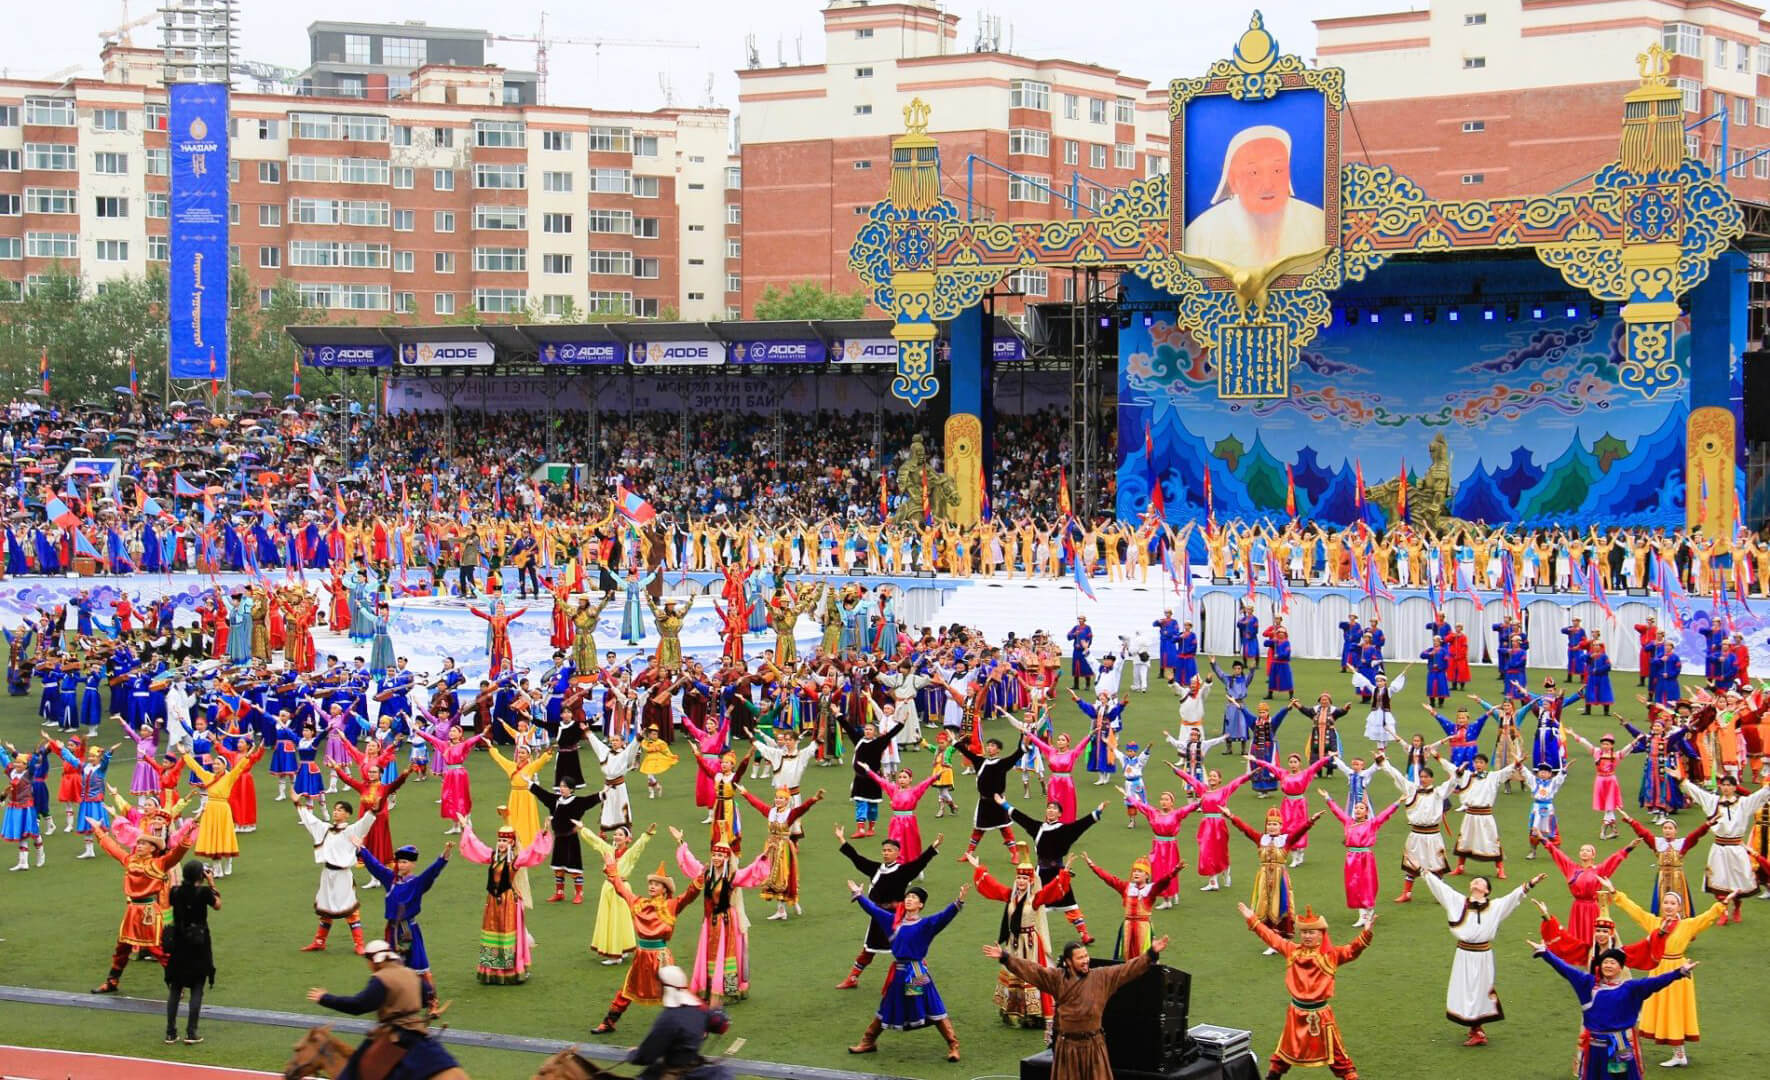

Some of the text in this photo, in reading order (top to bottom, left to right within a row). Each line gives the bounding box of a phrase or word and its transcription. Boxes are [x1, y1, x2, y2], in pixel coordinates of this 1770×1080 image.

[337, 349, 375, 359] AODE
[433, 348, 477, 359] AODE
[577, 346, 614, 355] AODE
[663, 347, 708, 358] AODE
[768, 344, 806, 354] AODE
[862, 345, 897, 356] AOD
